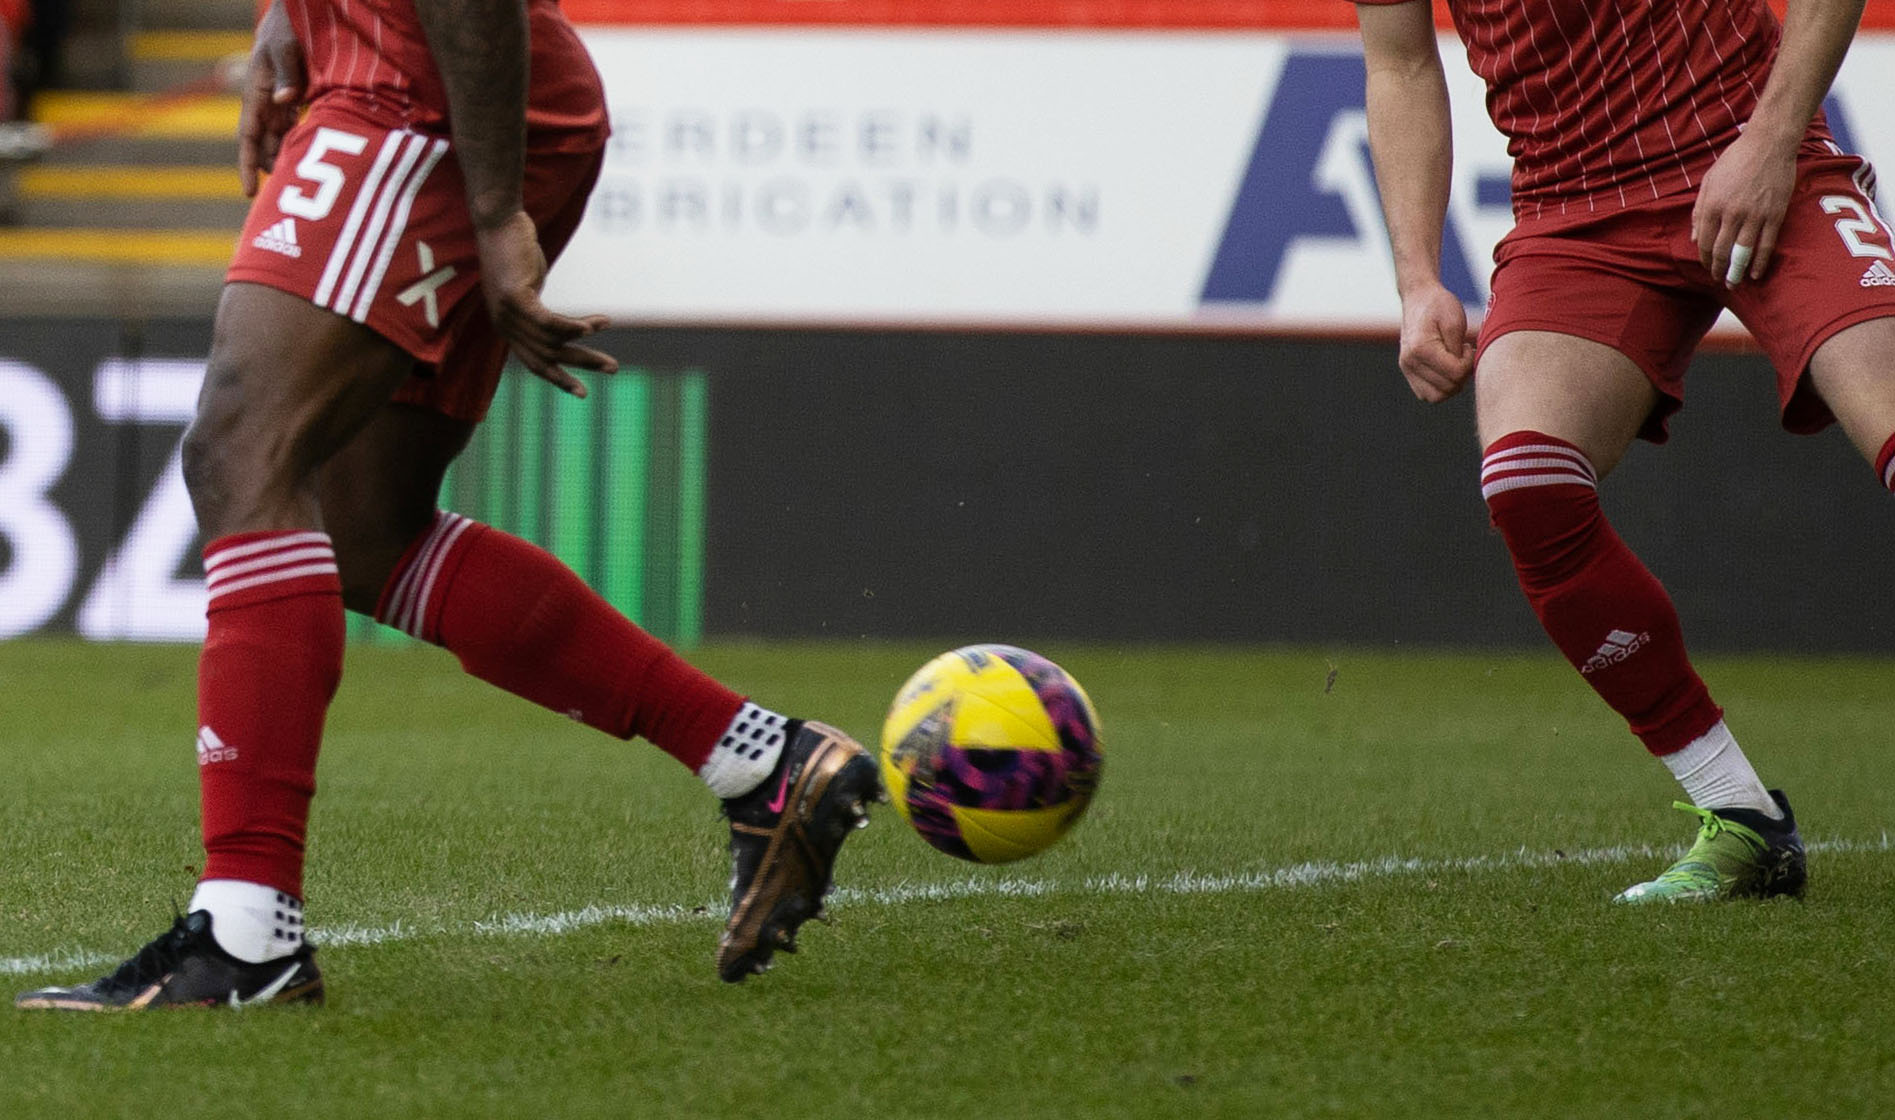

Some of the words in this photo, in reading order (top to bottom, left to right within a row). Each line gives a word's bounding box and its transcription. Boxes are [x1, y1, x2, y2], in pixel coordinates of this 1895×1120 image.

[278, 127, 369, 221] 5
[1819, 195, 1894, 261] 2
[1581, 631, 1651, 674] adidas
